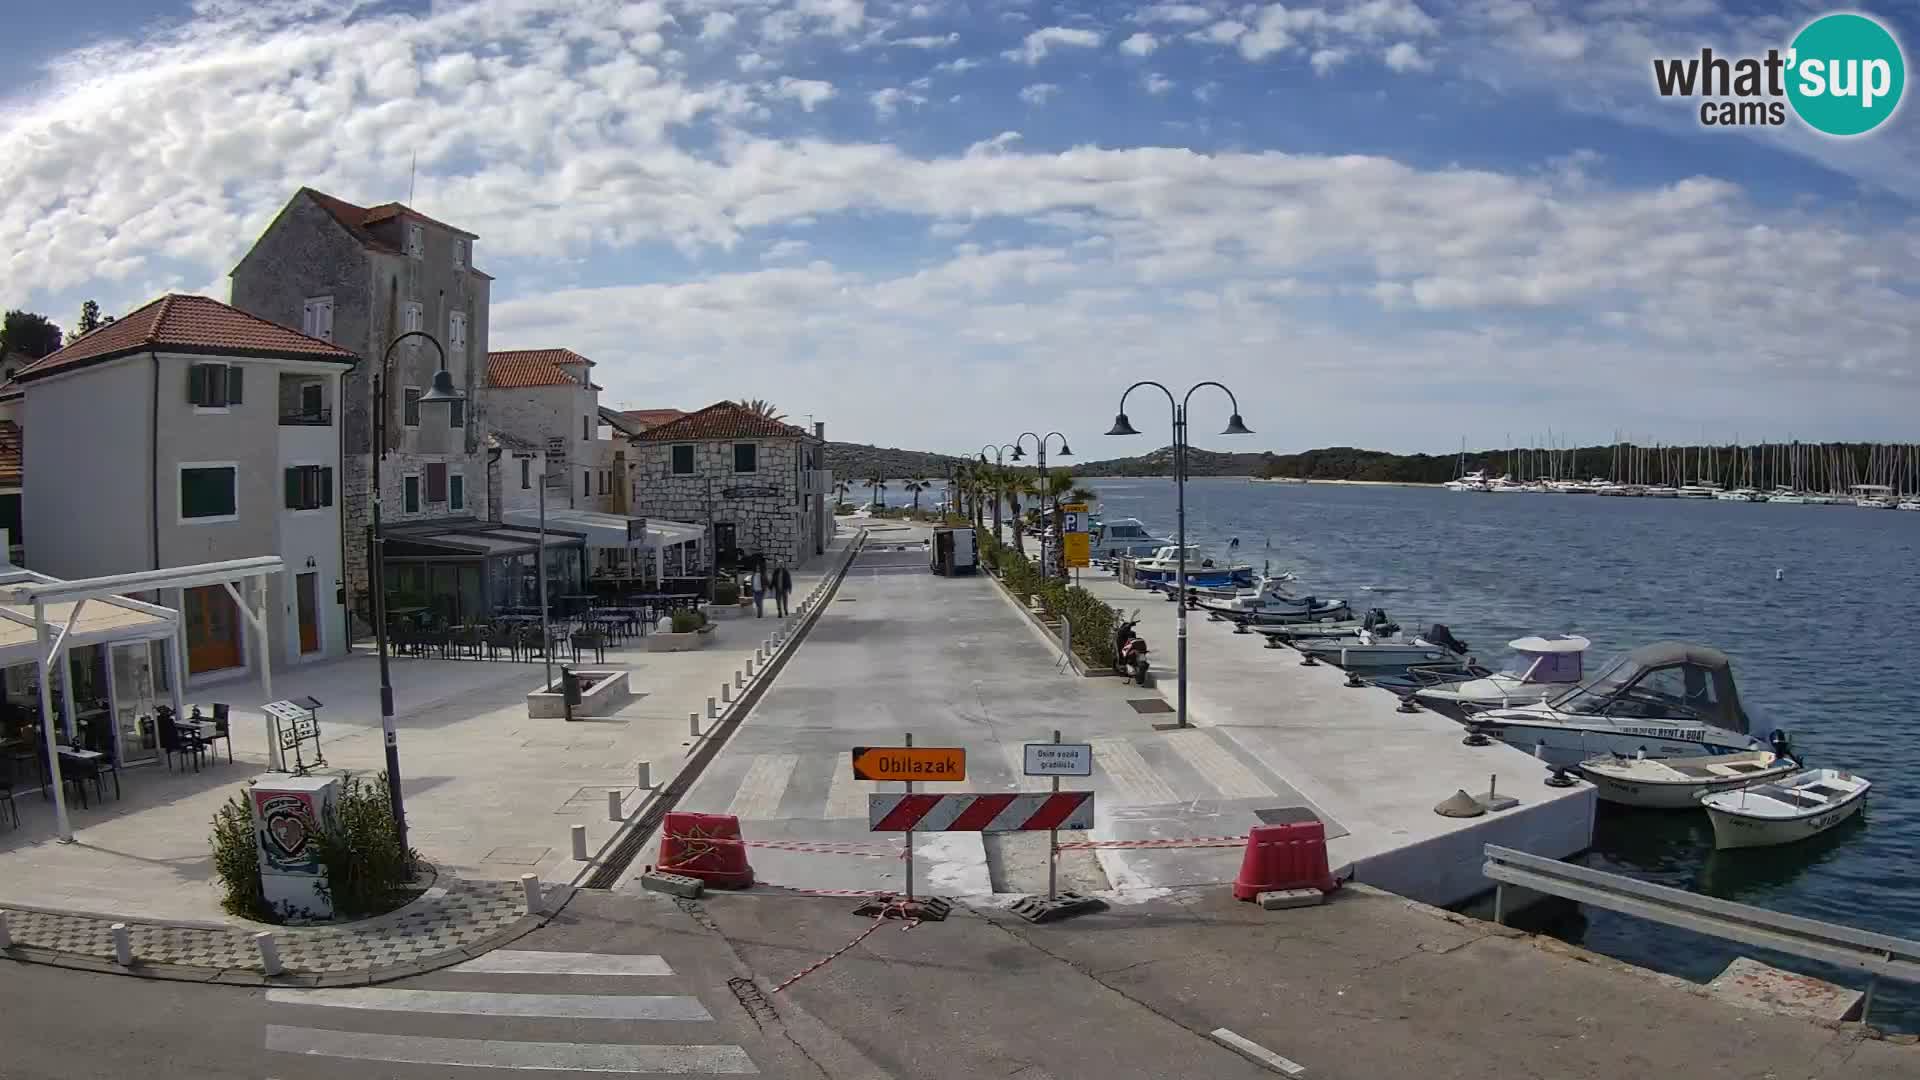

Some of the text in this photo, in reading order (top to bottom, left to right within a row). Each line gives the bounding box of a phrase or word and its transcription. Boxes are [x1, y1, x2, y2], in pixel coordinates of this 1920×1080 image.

[1658, 727, 1679, 738] RENT
[1686, 730, 1706, 742] BOAT
[879, 756, 957, 773] Obilazak
